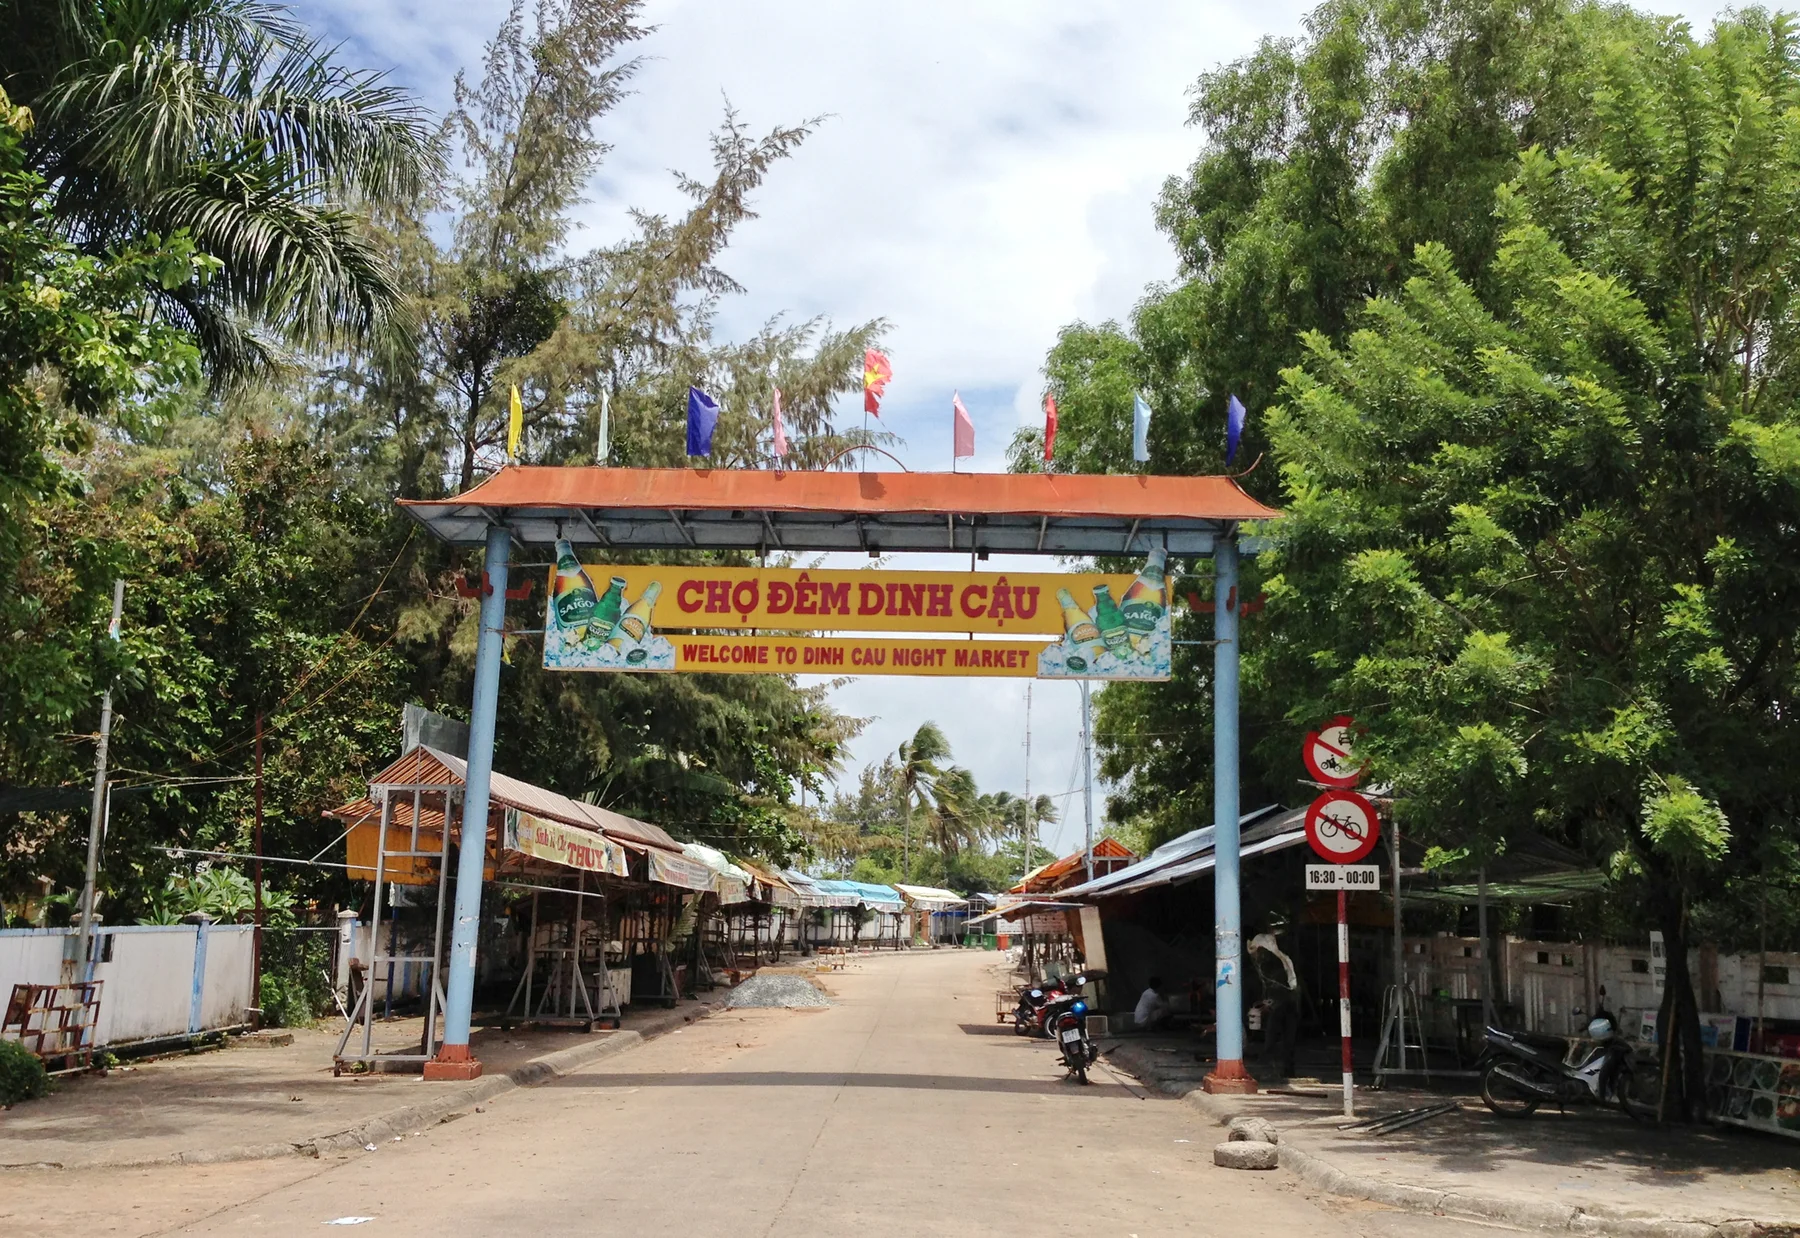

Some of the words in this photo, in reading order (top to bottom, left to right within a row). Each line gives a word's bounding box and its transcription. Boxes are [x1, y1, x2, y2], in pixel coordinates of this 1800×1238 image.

[677, 578, 759, 623] CHỢ
[767, 572, 851, 615] ĐÊM
[858, 583, 954, 617] DINH
[960, 576, 1040, 627] CẬU
[683, 644, 768, 664] WELCOME
[775, 647, 797, 664] TO
[804, 647, 844, 665] DINH
[851, 648, 885, 666] CAU
[893, 648, 946, 666] NIGHT
[954, 649, 1029, 668] MARKET
[1309, 871, 1335, 883] 16:30
[1346, 871, 1374, 883] 00:00
